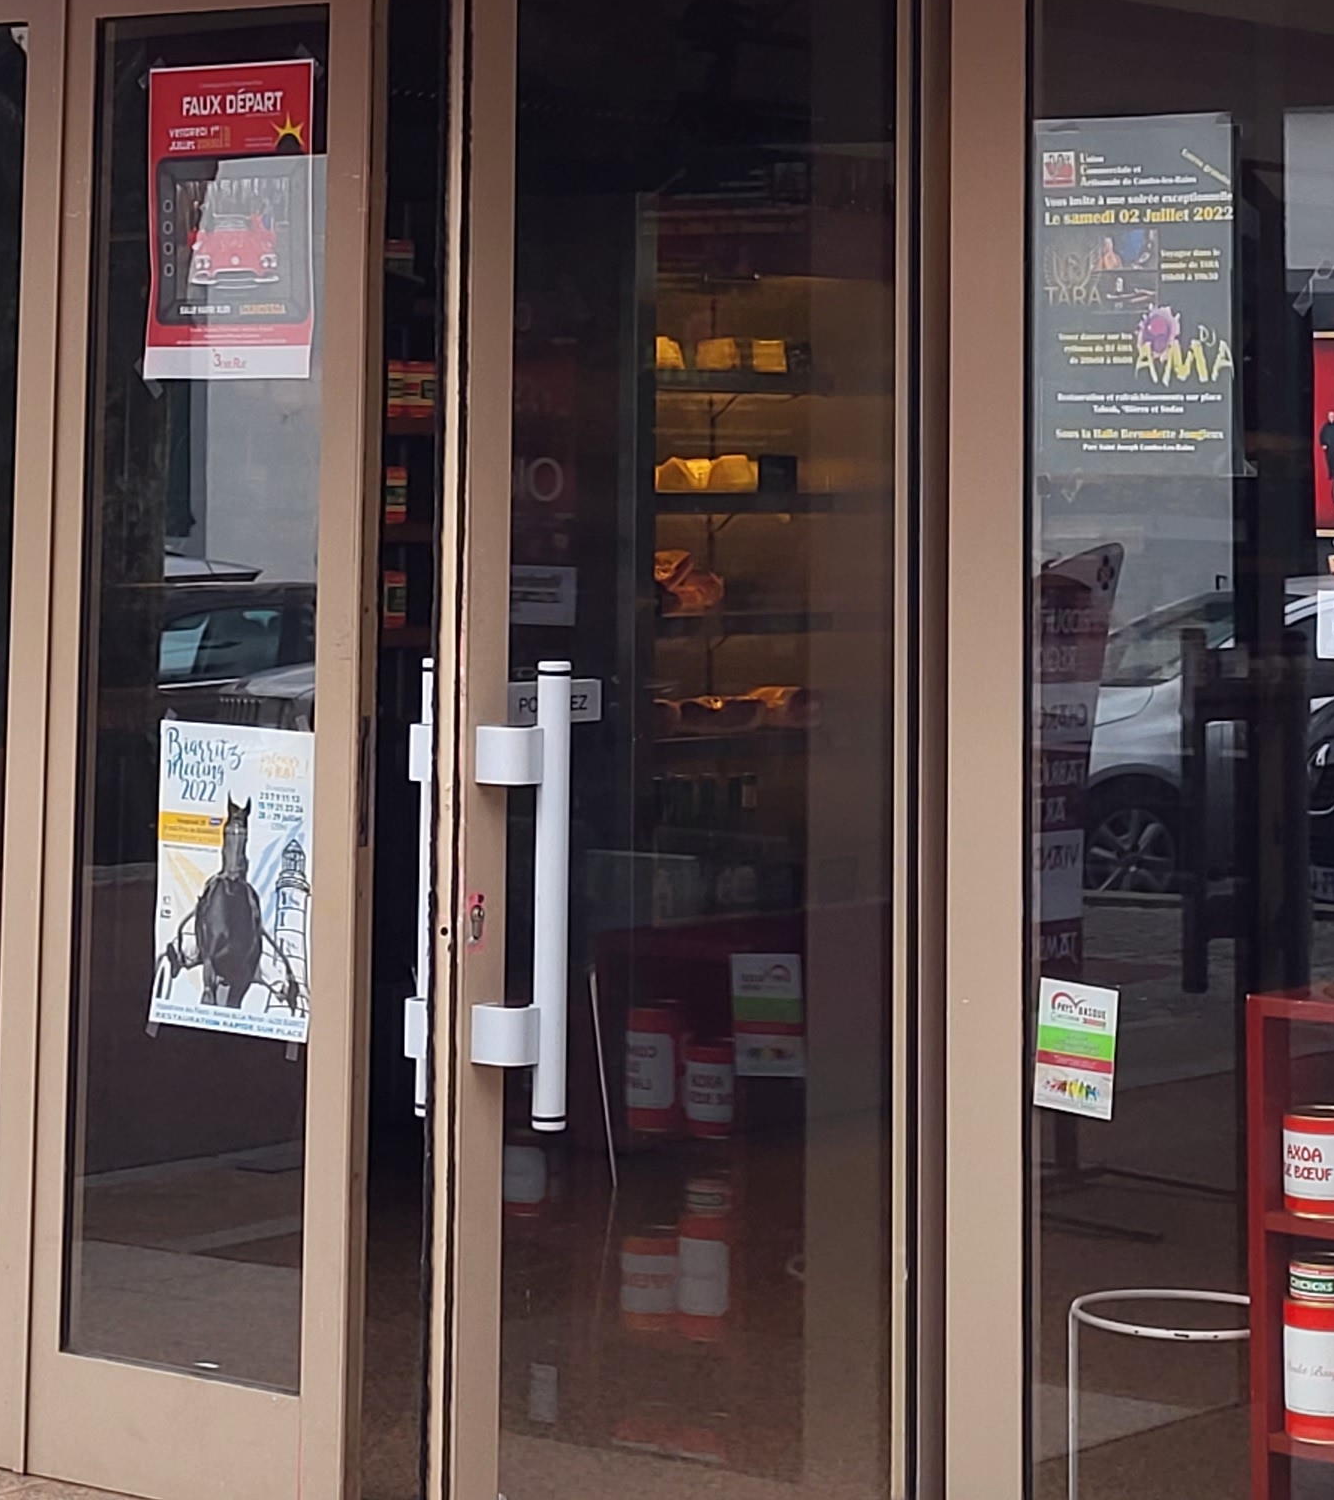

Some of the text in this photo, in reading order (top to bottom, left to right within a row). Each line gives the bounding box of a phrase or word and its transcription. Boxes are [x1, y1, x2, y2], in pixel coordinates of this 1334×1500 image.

[182, 88, 284, 117] FAUX DÉPART
[1044, 205, 1234, 226] Le samedi 02 Juillet 2022
[1043, 286, 1103, 306] TARA
[1134, 338, 1235, 387] AMA
[519, 695, 588, 713] POEZ
[166, 726, 246, 771] Biarritz
[167, 754, 224, 786] Meeting
[181, 779, 217, 803] 2022
[1287, 1143, 1323, 1163] AXOA
